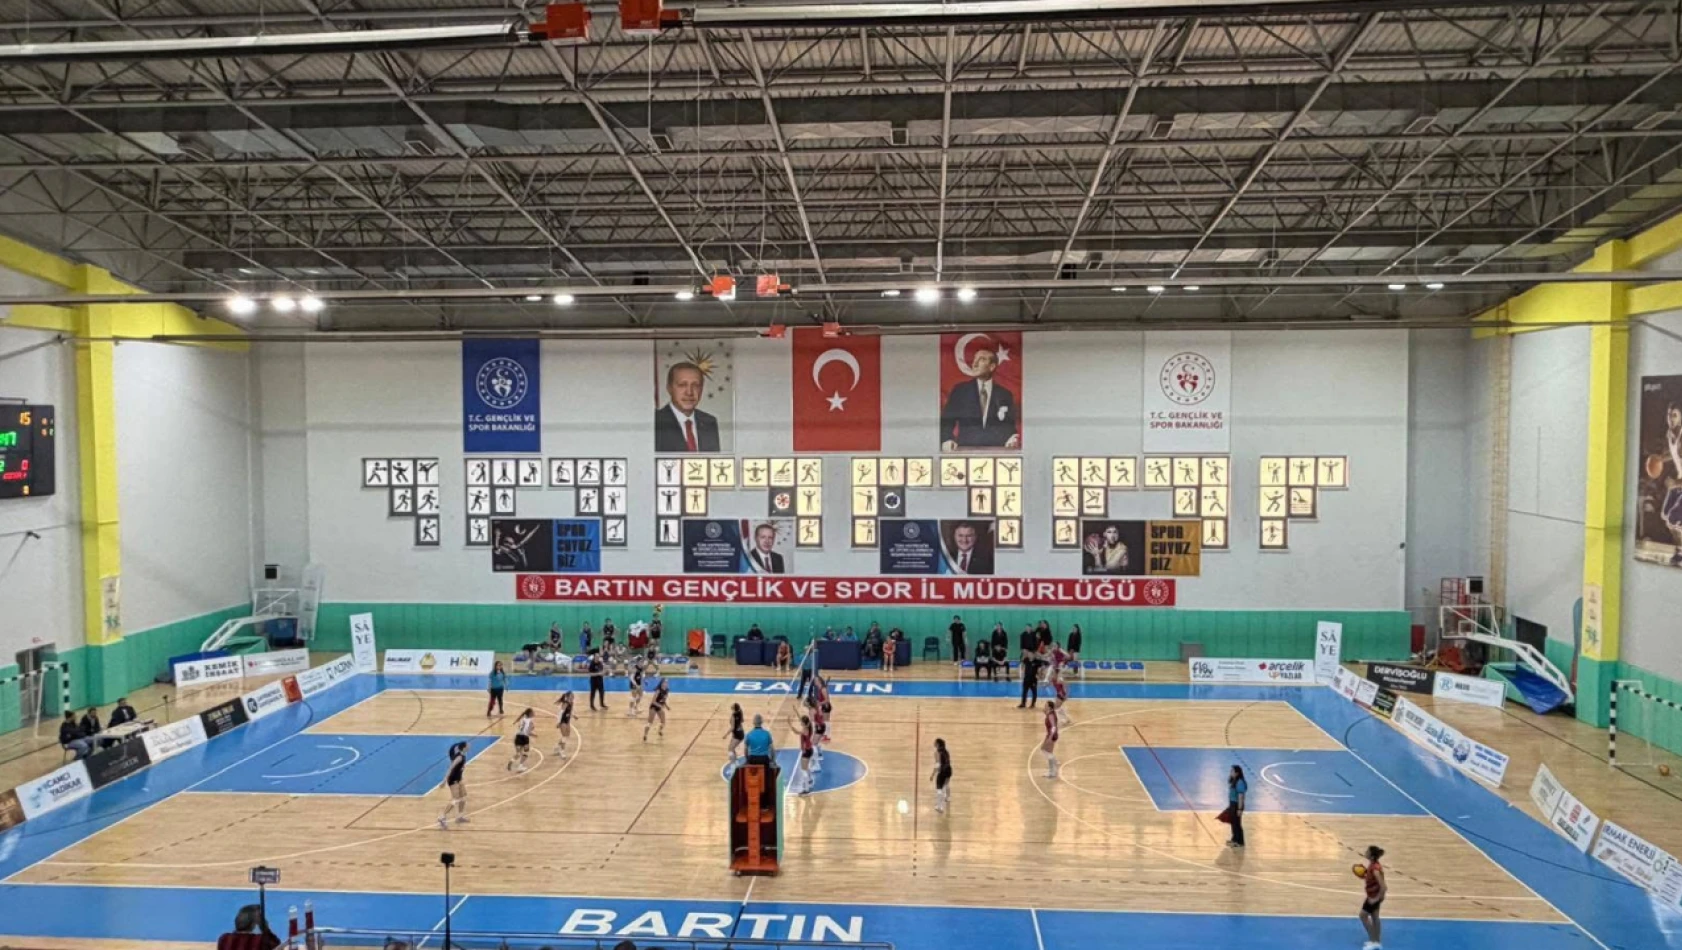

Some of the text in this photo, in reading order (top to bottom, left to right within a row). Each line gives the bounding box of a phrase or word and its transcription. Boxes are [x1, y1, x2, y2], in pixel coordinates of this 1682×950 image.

[468, 413, 535, 423] T.C. GENÇLİK VE
[1150, 410, 1223, 420] T.C. GENÇLİK VE
[491, 423, 536, 431] BAKANLIĞI
[1150, 420, 1223, 429] SPOR BAKANLIĞI
[1151, 525, 1183, 539] SPOR
[554, 577, 1136, 601] BARTIN GENÇLİK VE SPOR İL MÜDÜRLÜĞÜ
[355, 635, 372, 645] YE
[1320, 643, 1336, 656] YE
[734, 681, 893, 693] BATIN
[559, 908, 863, 942] BARTIN
